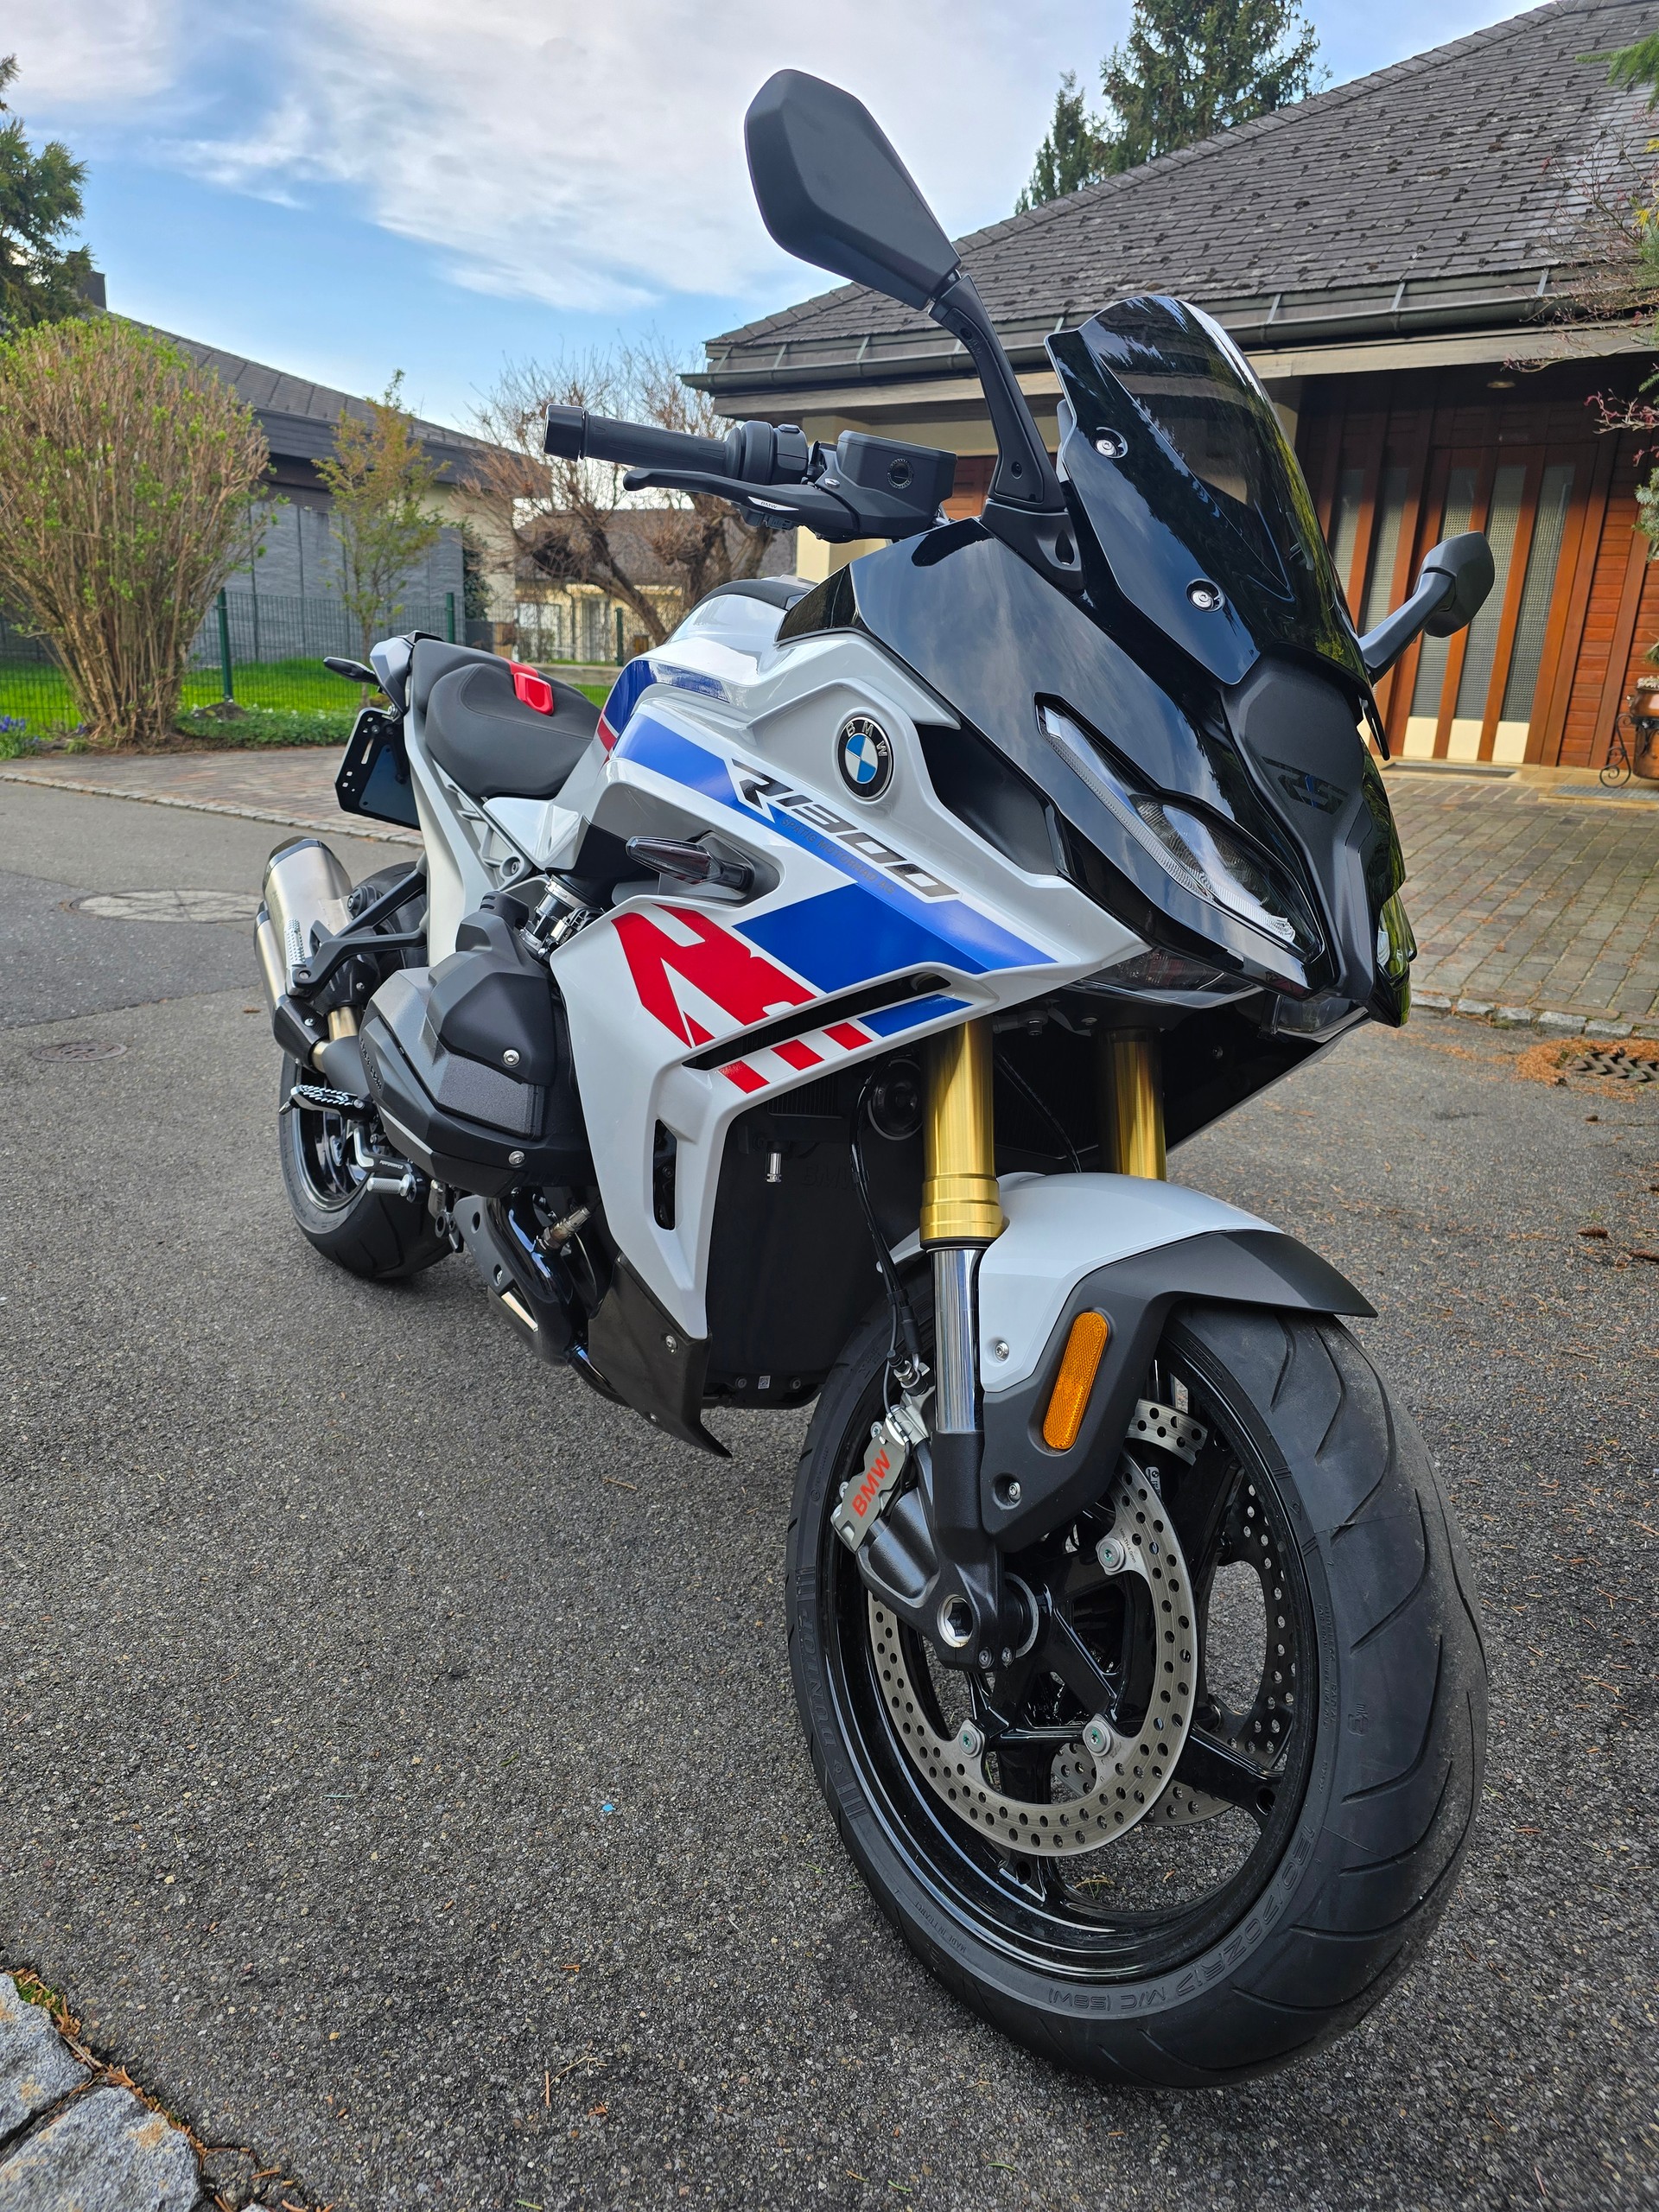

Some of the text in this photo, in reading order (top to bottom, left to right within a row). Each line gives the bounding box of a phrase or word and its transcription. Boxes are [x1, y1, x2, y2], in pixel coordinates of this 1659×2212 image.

[731, 758, 961, 899] R1300
[817, 838, 878, 882] MOTORRAD
[877, 879, 896, 895] AG
[851, 1448, 891, 1518] BMW
[801, 1609, 837, 1747] DUNLOP
